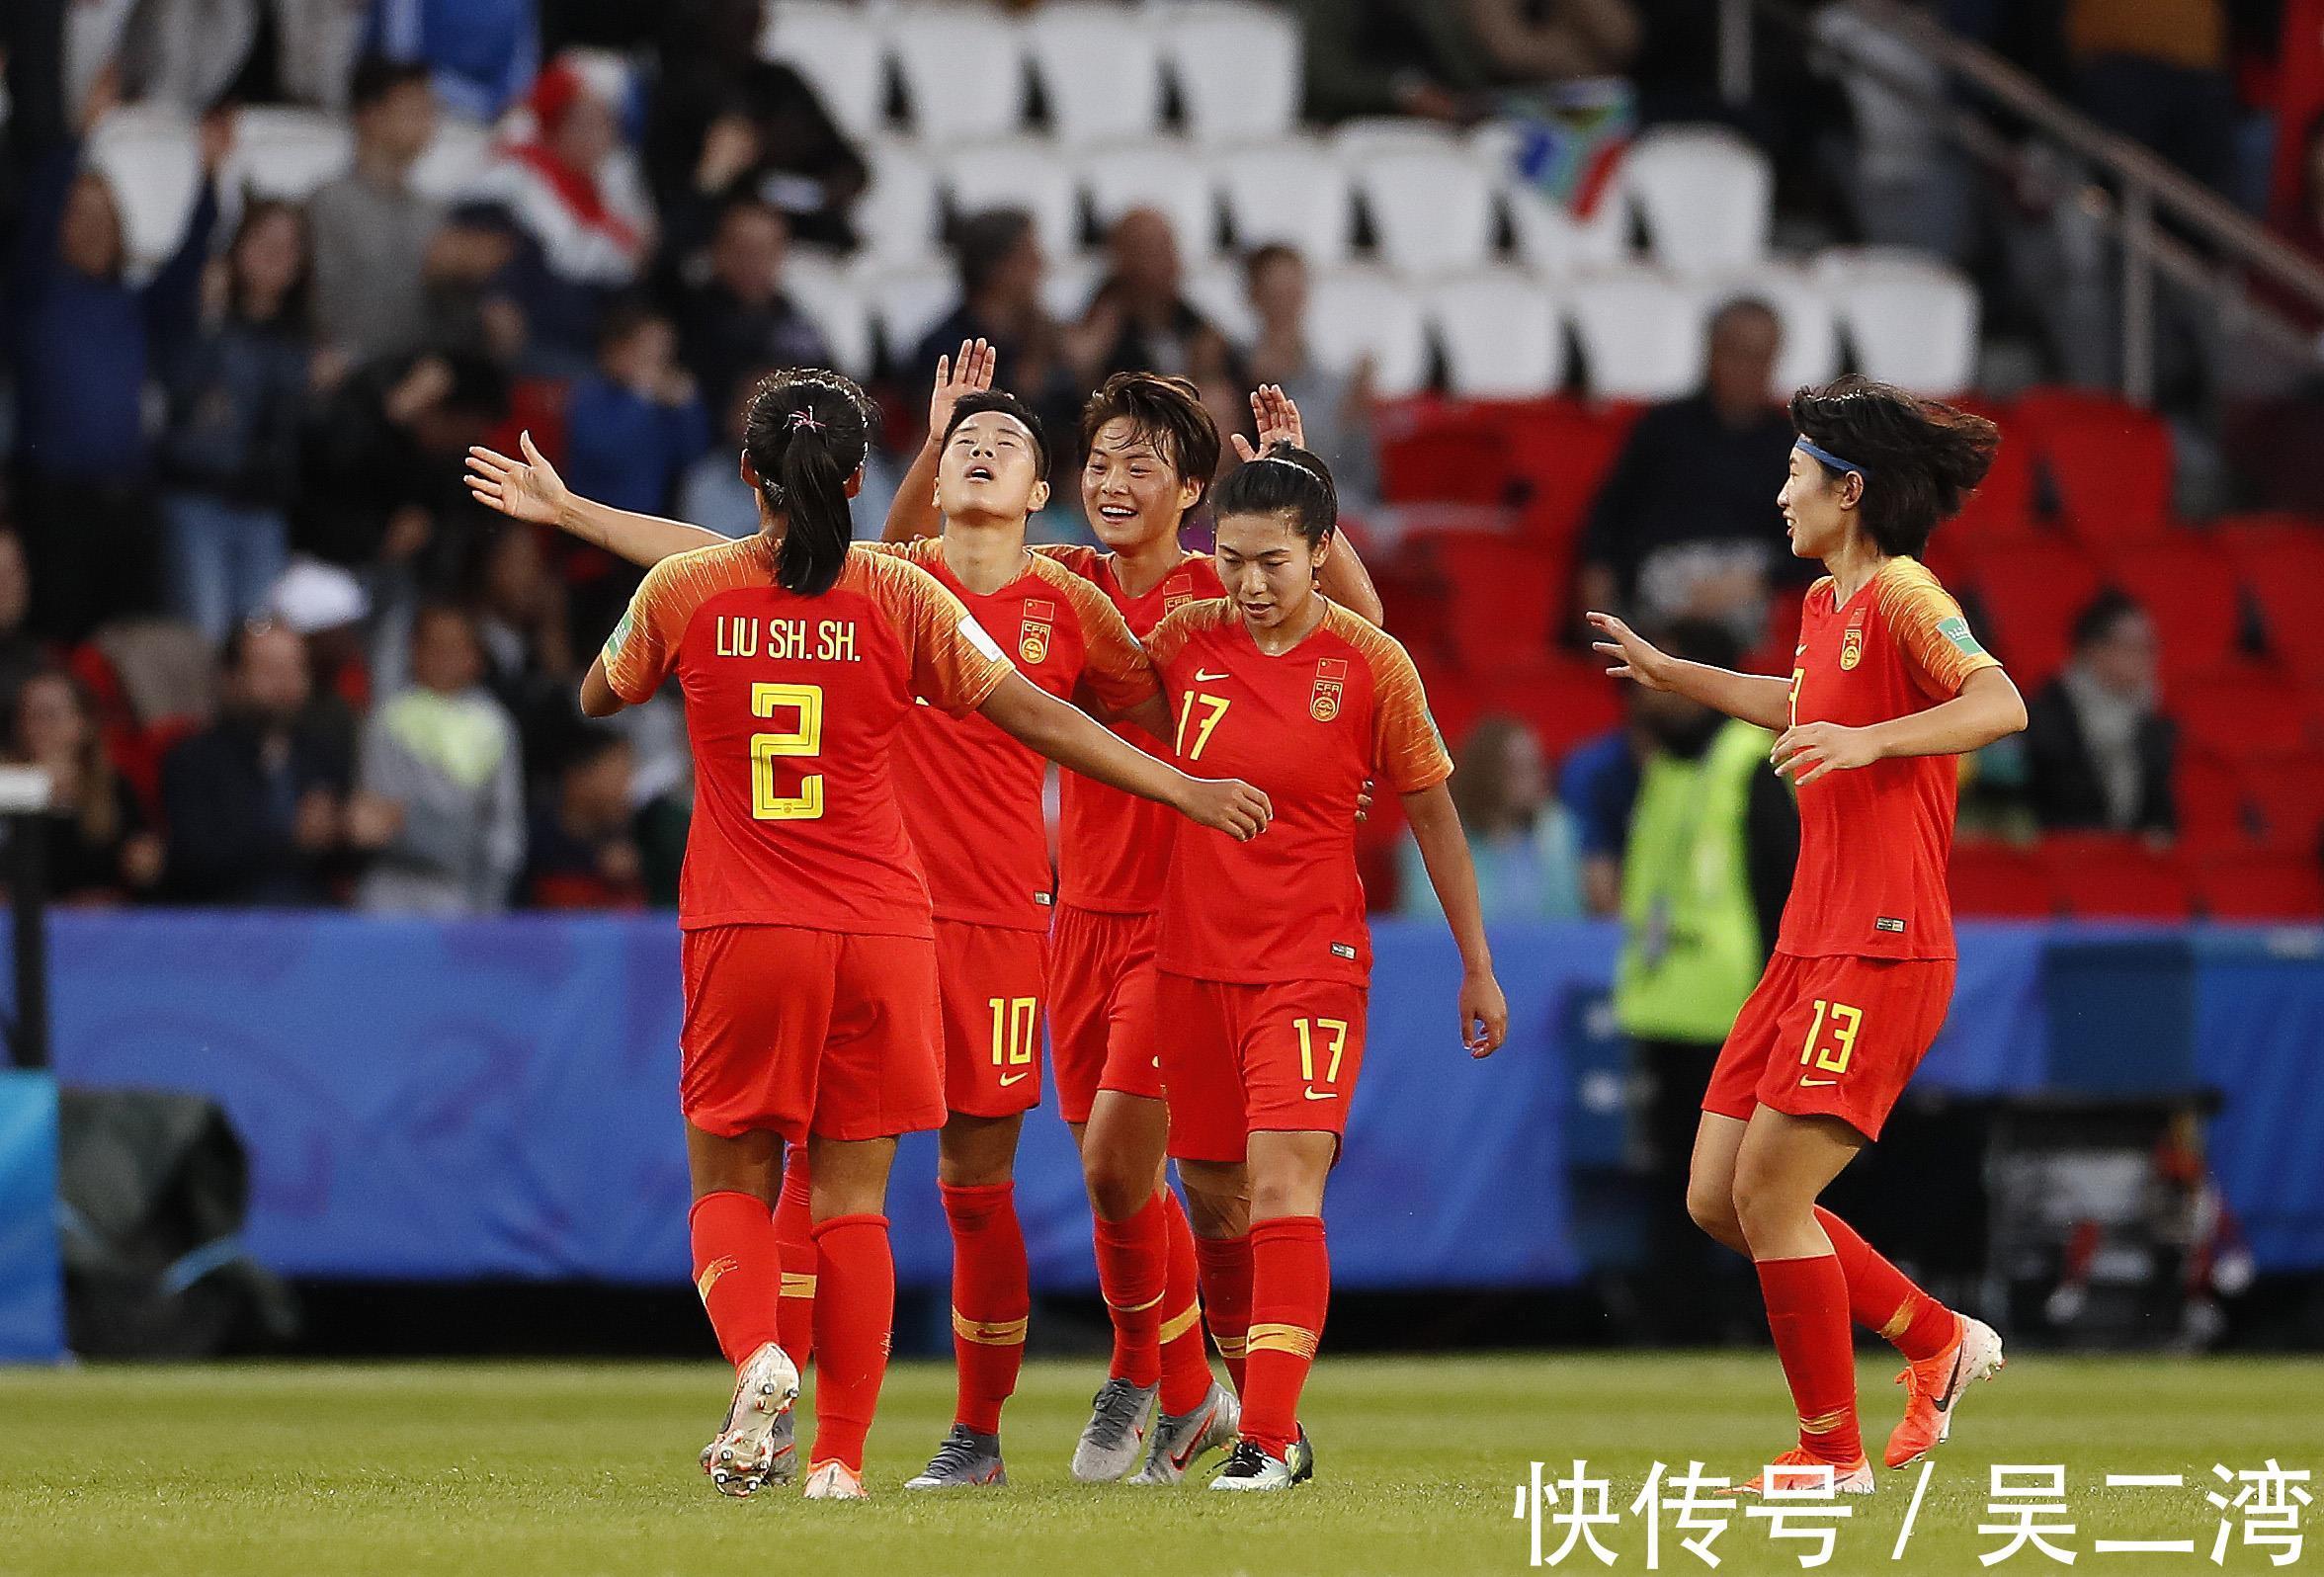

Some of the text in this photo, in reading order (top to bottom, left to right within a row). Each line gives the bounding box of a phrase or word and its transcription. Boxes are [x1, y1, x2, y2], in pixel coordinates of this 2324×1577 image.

[716, 616, 759, 657] LIU
[1024, 623, 1048, 635] CFA
[1315, 682, 1340, 693] CFA
[750, 682, 824, 820] 2
[1175, 690, 1231, 761] 17
[988, 997, 1037, 1065] 10
[1292, 1018, 1348, 1083] 17
[1799, 999, 1863, 1074] 13
